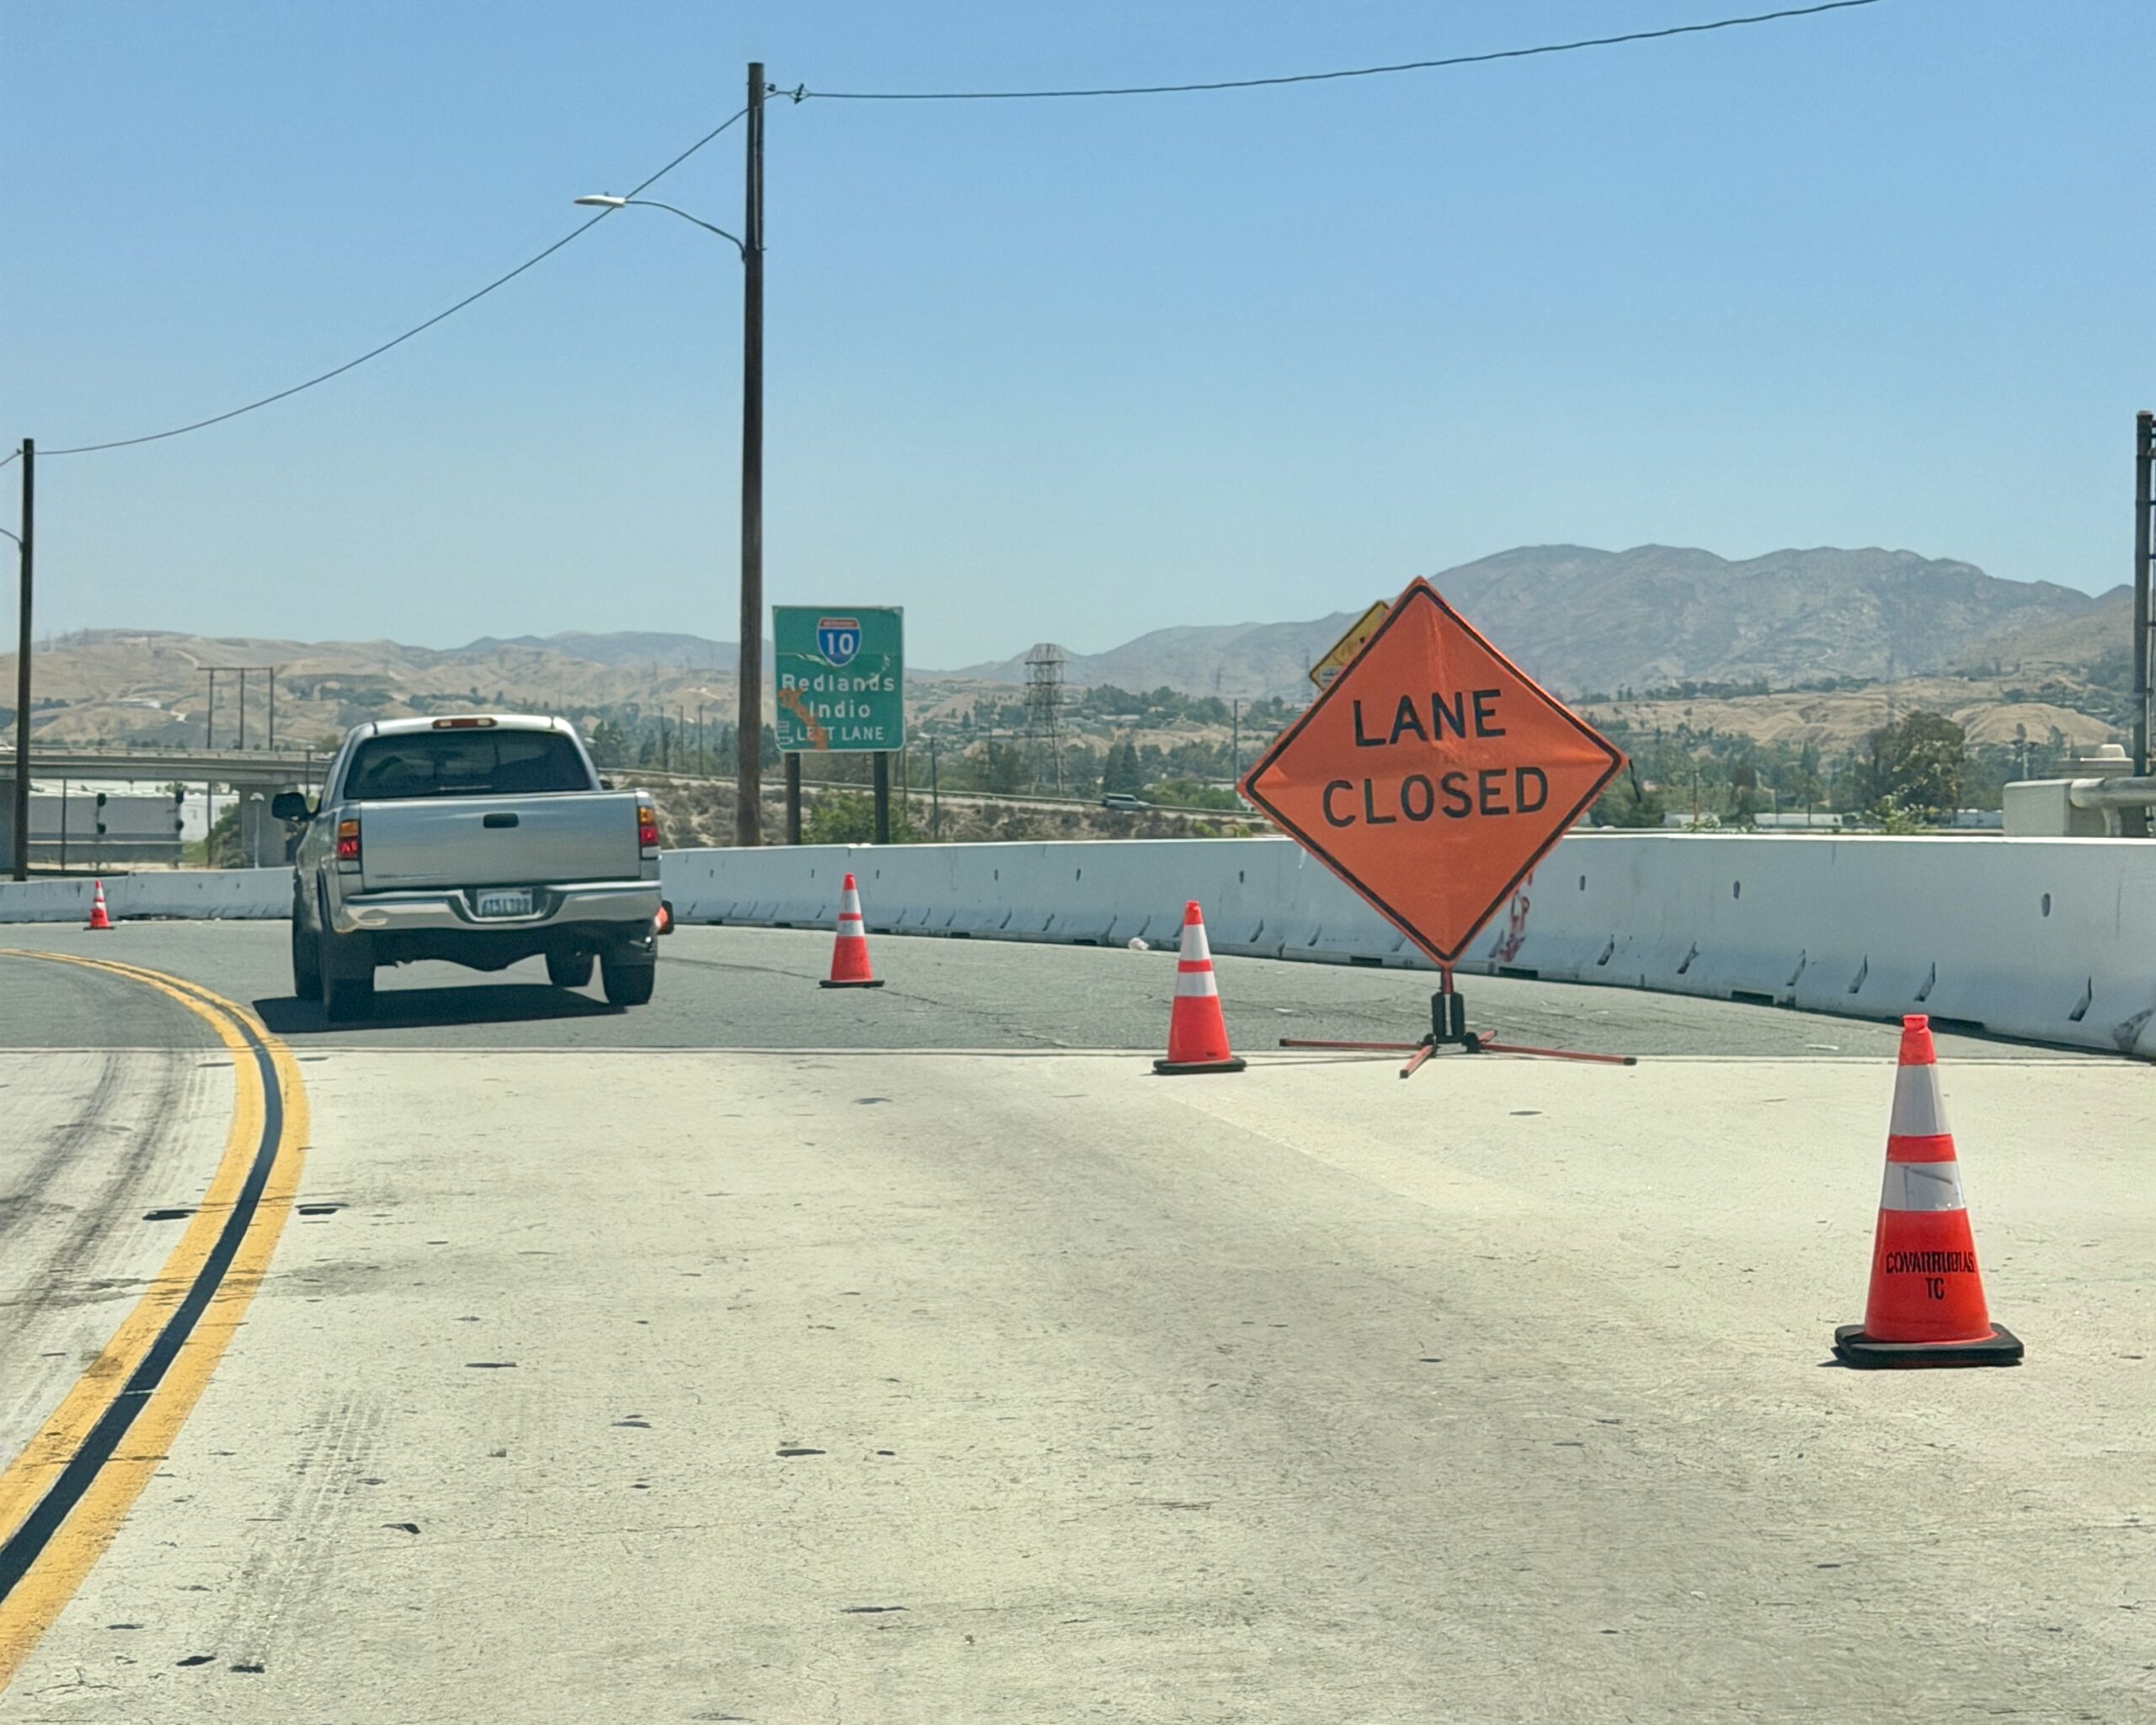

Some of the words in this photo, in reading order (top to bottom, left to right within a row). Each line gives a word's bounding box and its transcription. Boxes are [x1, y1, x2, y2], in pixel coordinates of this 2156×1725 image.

[827, 633, 854, 655] 10
[782, 674, 895, 692] Redlands
[809, 700, 871, 718] Indio
[1353, 688, 1506, 746] LANE
[797, 726, 835, 740] LET
[842, 726, 884, 741] LANE
[1322, 766, 1549, 828] CLOSED
[1924, 1277, 1945, 1300] TC
